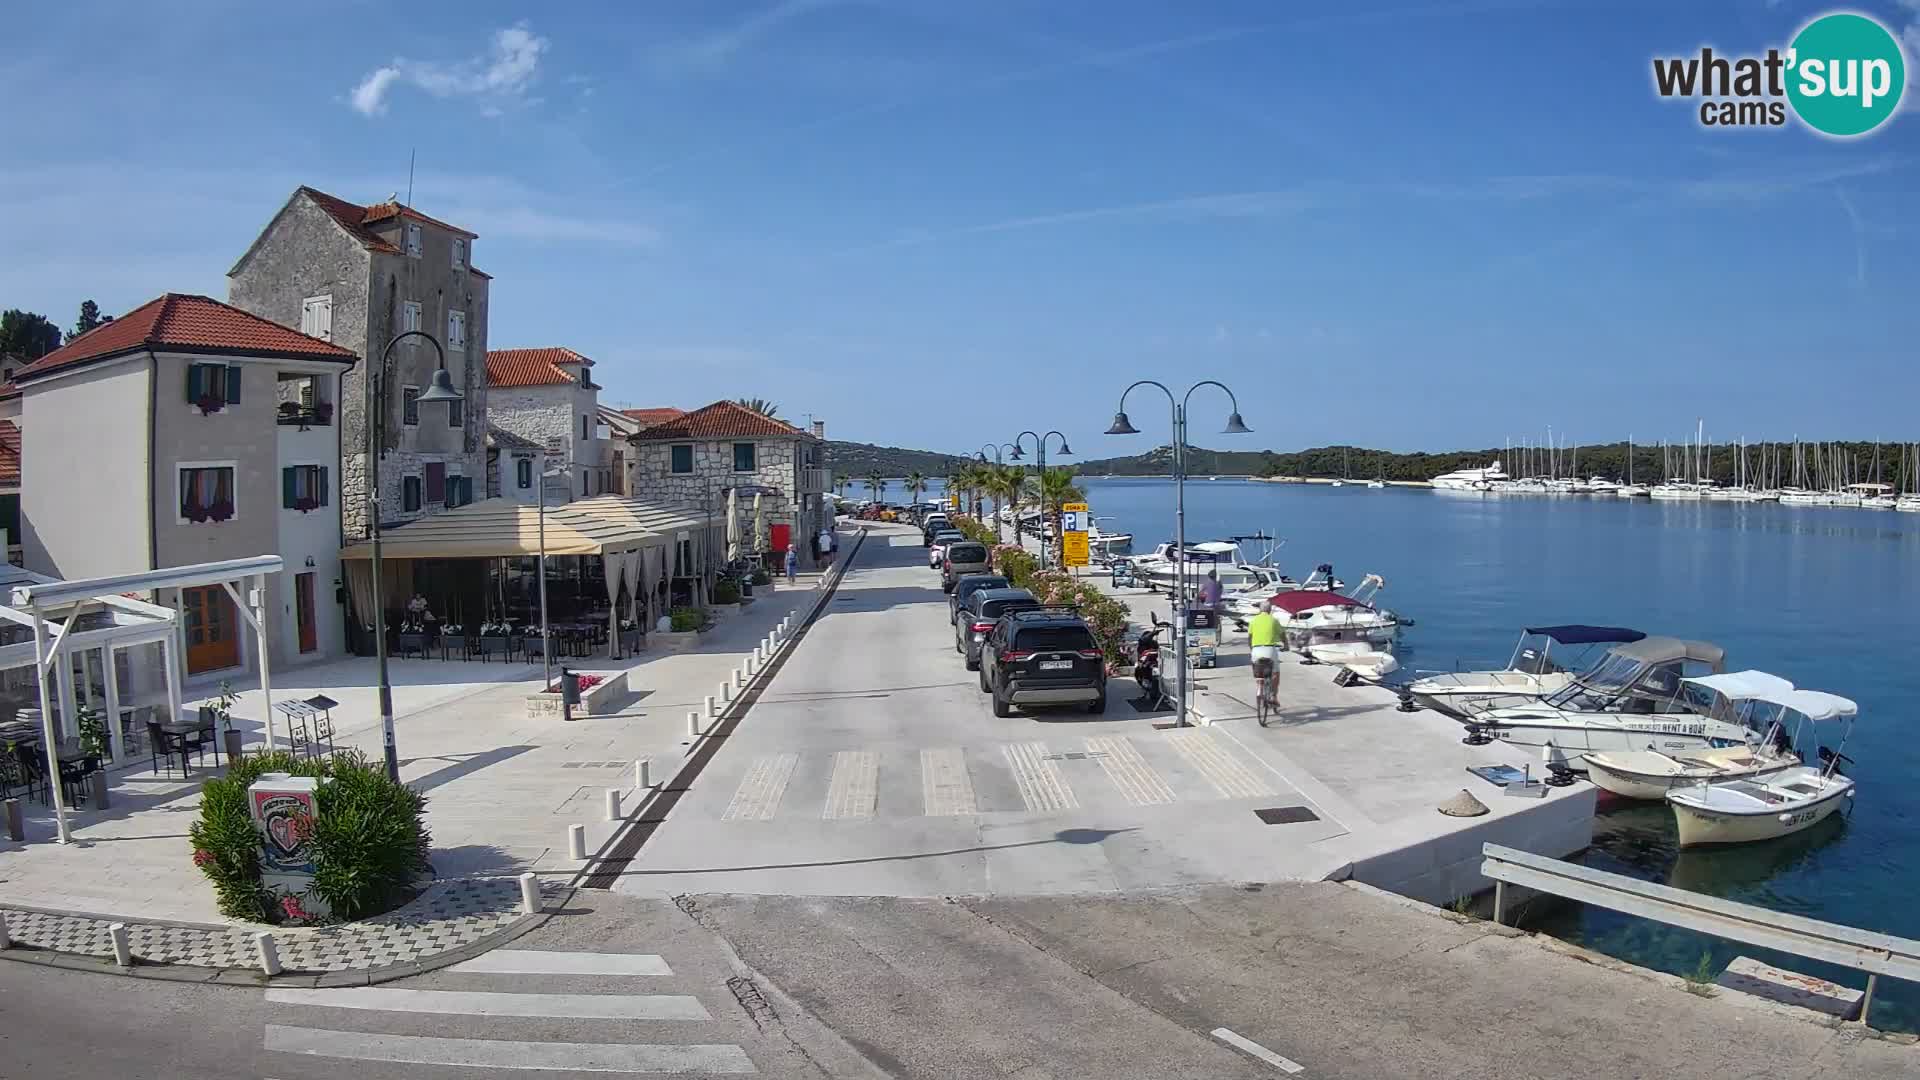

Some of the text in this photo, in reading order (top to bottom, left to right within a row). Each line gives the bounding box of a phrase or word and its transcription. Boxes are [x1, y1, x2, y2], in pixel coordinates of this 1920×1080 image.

[1065, 513, 1076, 531] P
[1662, 723, 1681, 733] RENT
[1682, 724, 1688, 733] A
[1689, 723, 1707, 735] BOAT
